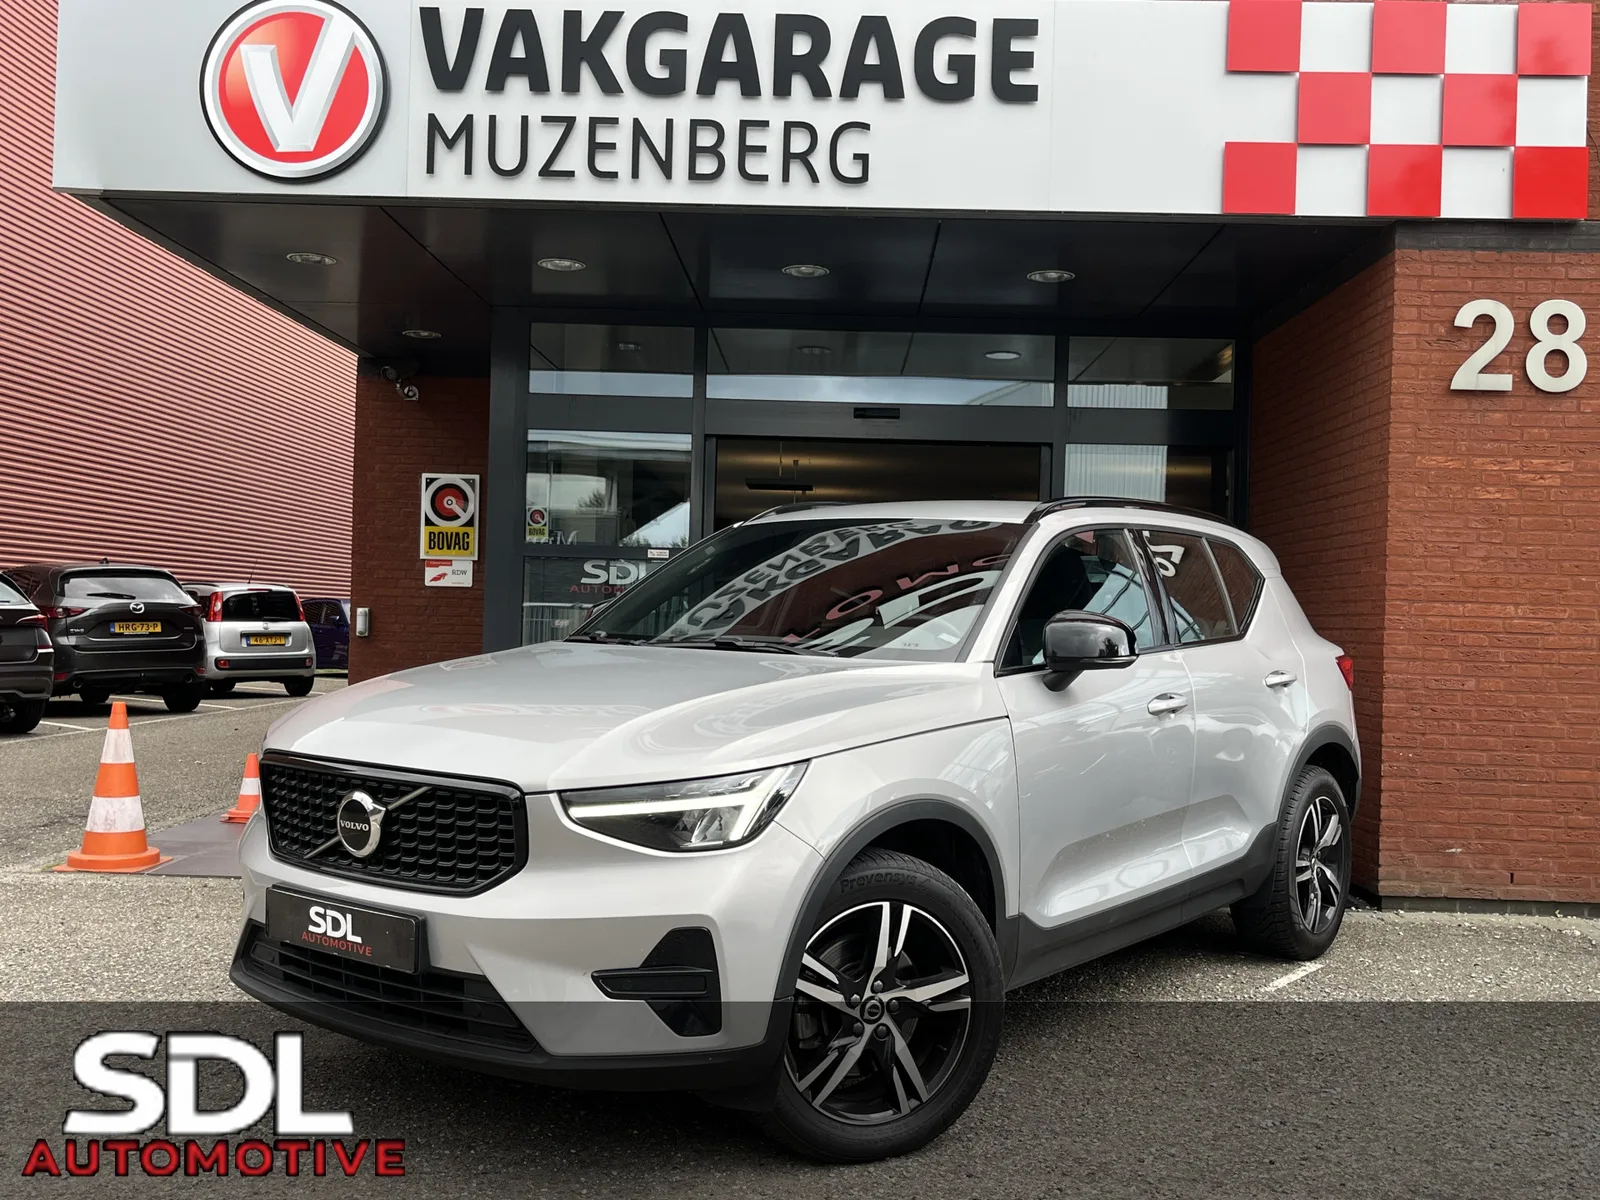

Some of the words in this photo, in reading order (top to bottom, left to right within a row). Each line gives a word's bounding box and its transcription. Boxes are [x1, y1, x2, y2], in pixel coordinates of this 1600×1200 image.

[419, 7, 1039, 103] VAKGARAGE
[239, 12, 357, 153] V
[426, 114, 870, 185] MUZENBERG
[1450, 299, 1588, 393] 28
[428, 531, 470, 551] BOVAG
[528, 527, 546, 536] BOVAG
[118, 622, 159, 632] HRG-73-P
[339, 819, 370, 832] VOLVO
[840, 872, 917, 894] Prevensys
[307, 905, 363, 944] SDL
[301, 931, 373, 957] AUTOMOTIVE
